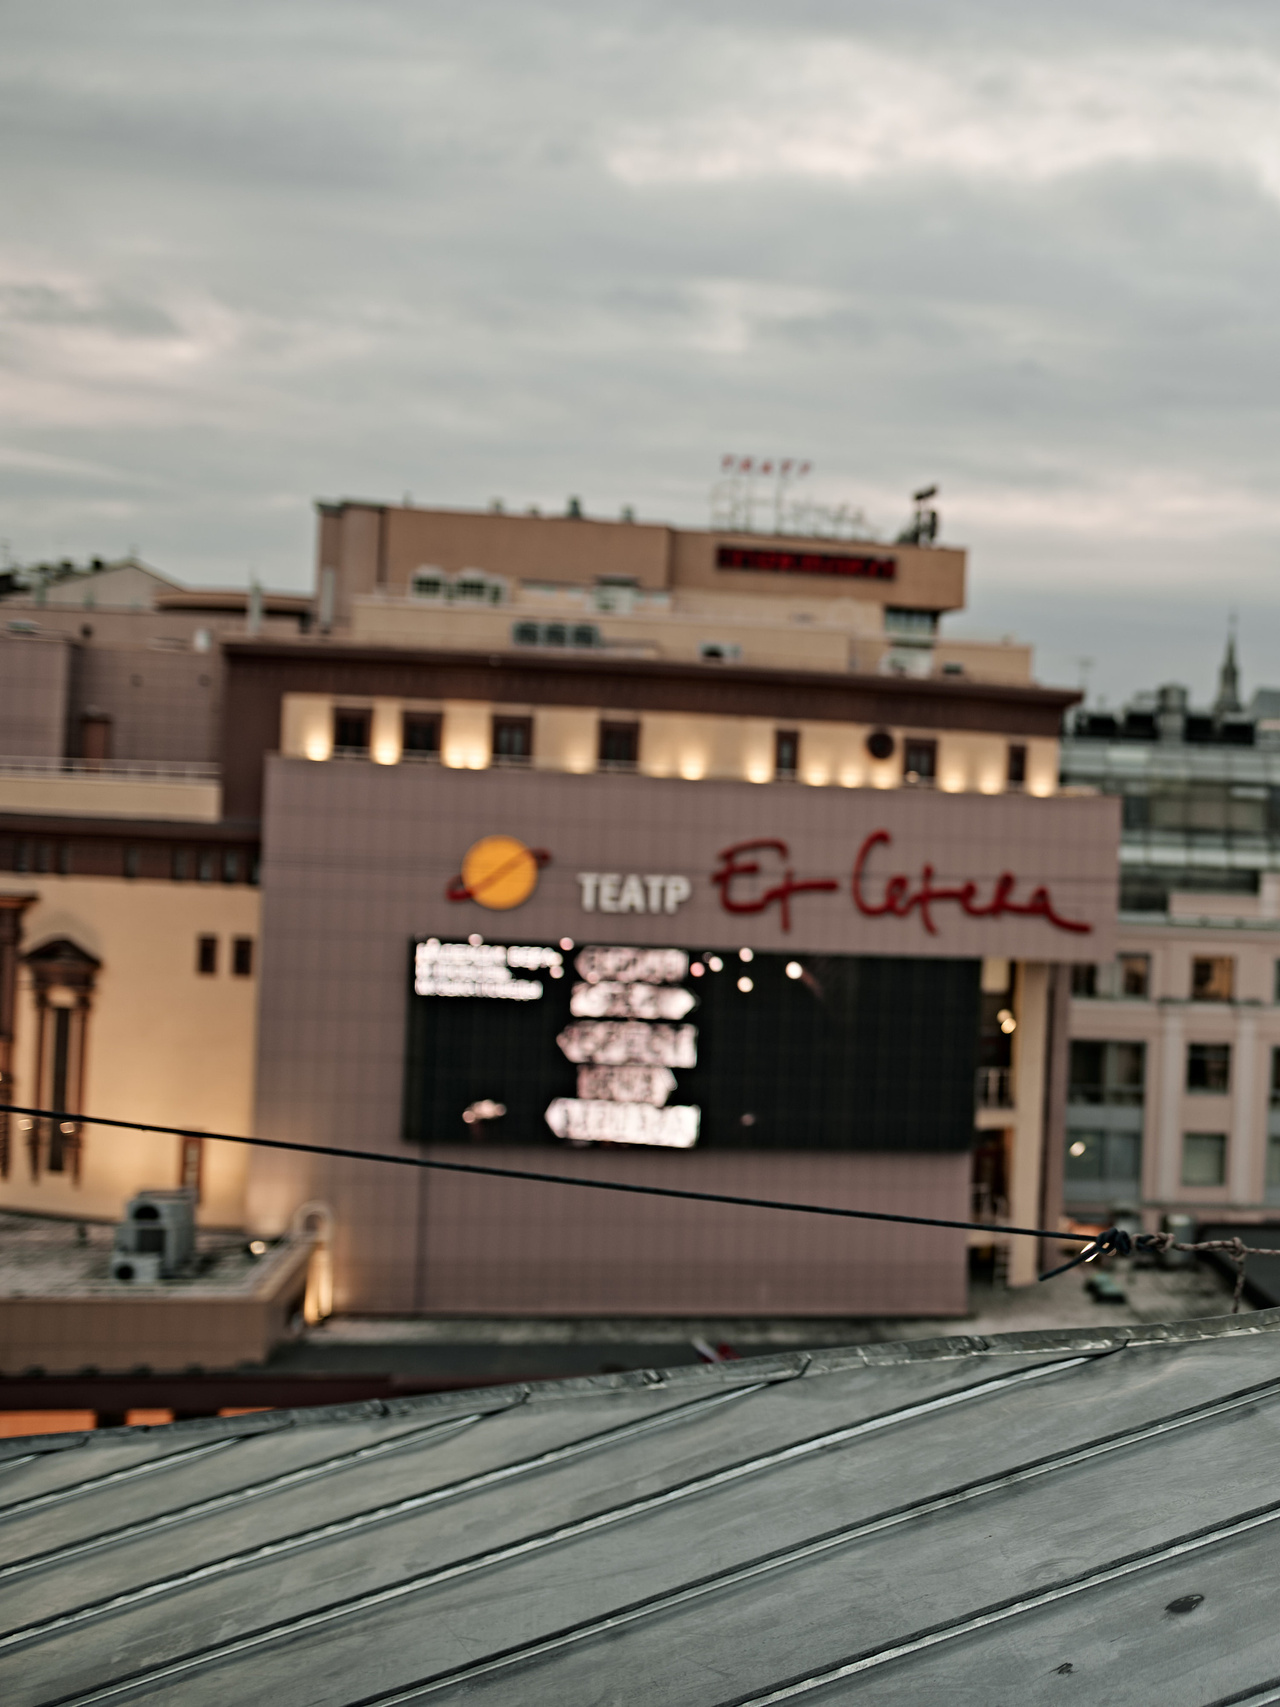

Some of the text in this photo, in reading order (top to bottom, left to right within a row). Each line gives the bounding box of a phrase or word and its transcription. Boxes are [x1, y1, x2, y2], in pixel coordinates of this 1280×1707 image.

[577, 873, 691, 914] ТЕАТР
[712, 829, 1093, 936] Et Cetera
